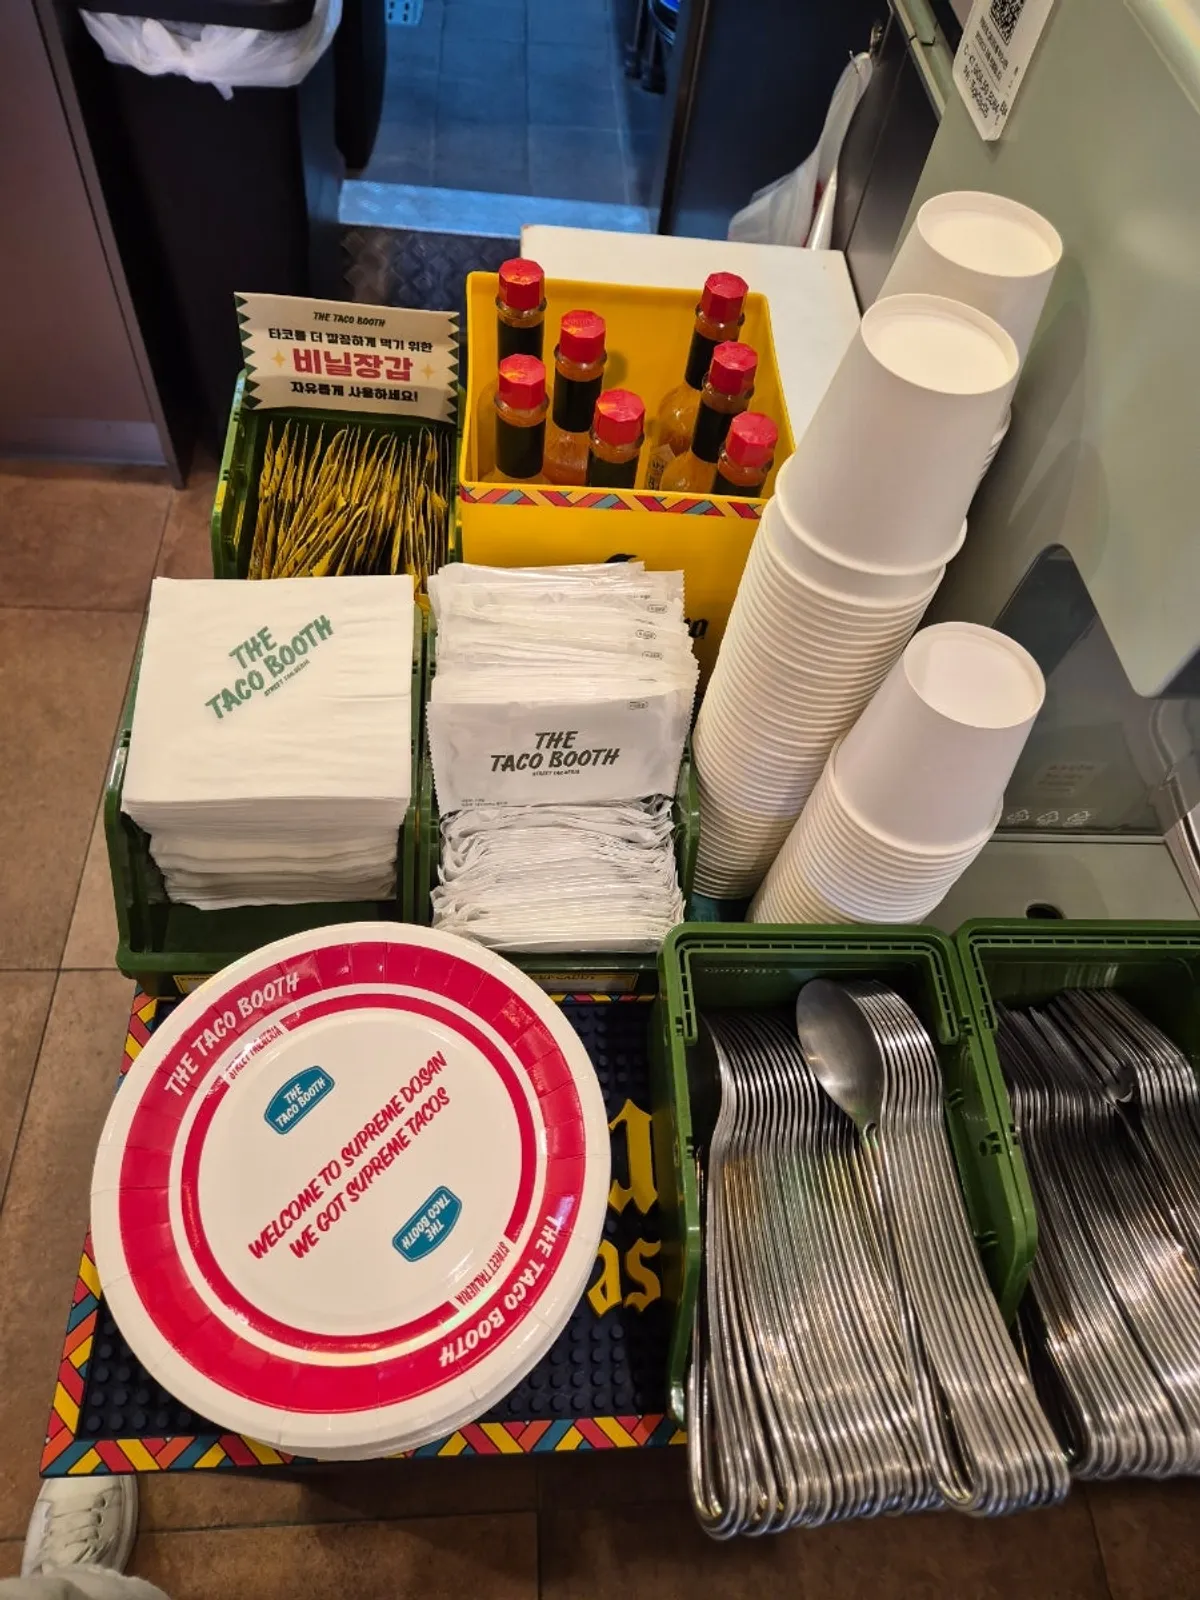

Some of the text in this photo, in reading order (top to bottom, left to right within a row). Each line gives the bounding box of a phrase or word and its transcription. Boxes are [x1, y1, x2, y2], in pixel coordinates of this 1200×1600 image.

[268, 327, 433, 353] 타코를 더 깔끔하게 먹기 위한
[313, 311, 386, 327] THE TACO BOOTH
[292, 348, 414, 382] 비닐장갑
[290, 381, 418, 402] 자유롭게 사용하세요!
[204, 669, 265, 719] TACO
[262, 614, 334, 678] BOOTH
[228, 625, 277, 669] THE
[490, 748, 621, 772] TACO BOOTH
[535, 730, 578, 750] THE
[164, 971, 300, 1097] THE TACO BOOTH
[275, 1077, 326, 1128] TACO BOOTH
[283, 1083, 304, 1104] THE
[248, 1050, 448, 1260] WELCOME TO SUPREME DOSAN
[289, 1086, 451, 1259] WE GOT SUPREME TACOS
[401, 1193, 451, 1250] TACO BOOTH
[424, 1219, 445, 1243] THE
[438, 1215, 564, 1368] THE TACO BOOTH
[454, 1241, 511, 1306] STREET TAQUERIA
